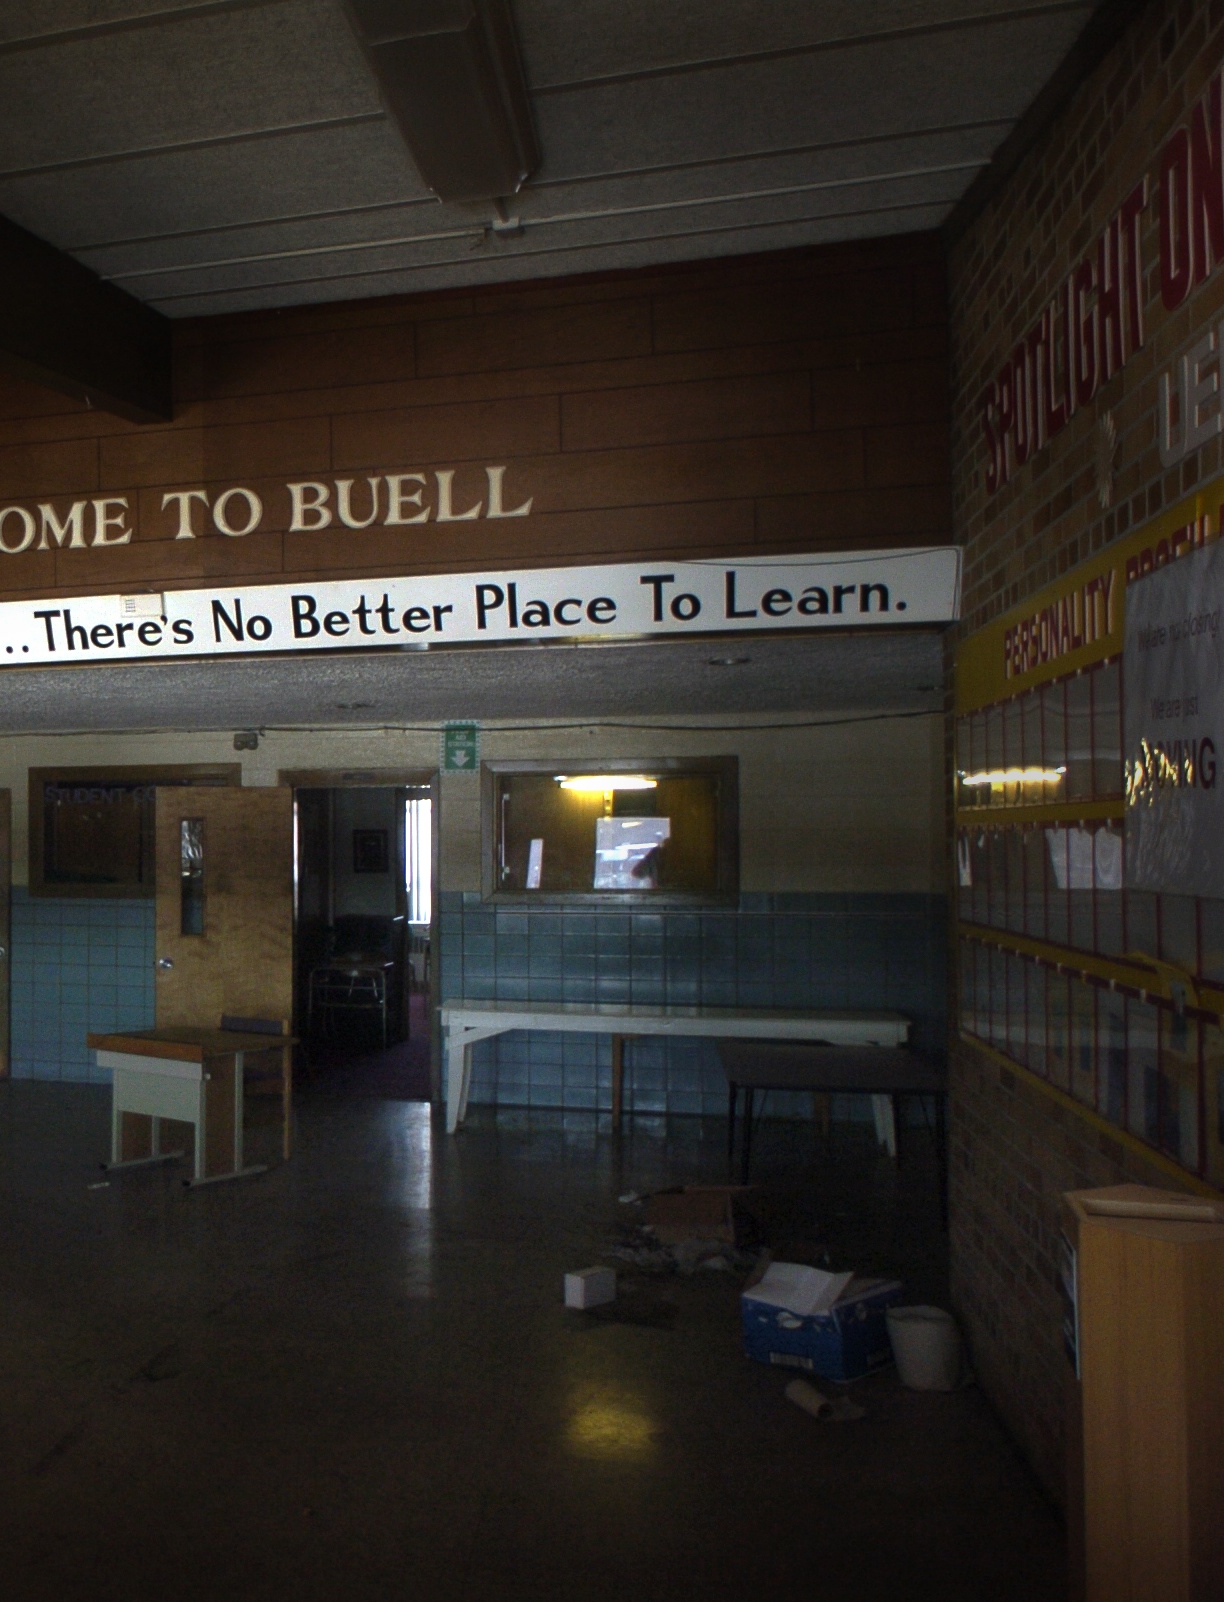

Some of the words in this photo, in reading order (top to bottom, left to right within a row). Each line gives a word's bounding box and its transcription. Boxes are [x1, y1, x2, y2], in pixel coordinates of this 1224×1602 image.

[984, 172, 1148, 496] SPOTLIGHT
[1158, 64, 1224, 311] ON
[161, 487, 263, 541] TO
[286, 465, 533, 532] BUELL
[211, 597, 273, 643] No
[290, 592, 454, 639] Better
[475, 581, 617, 630] Place
[639, 573, 702, 623] To
[724, 570, 908, 619] Learn.
[1004, 568, 1117, 680] PERSONALITY
[45, 785, 127, 804] STUDENT
